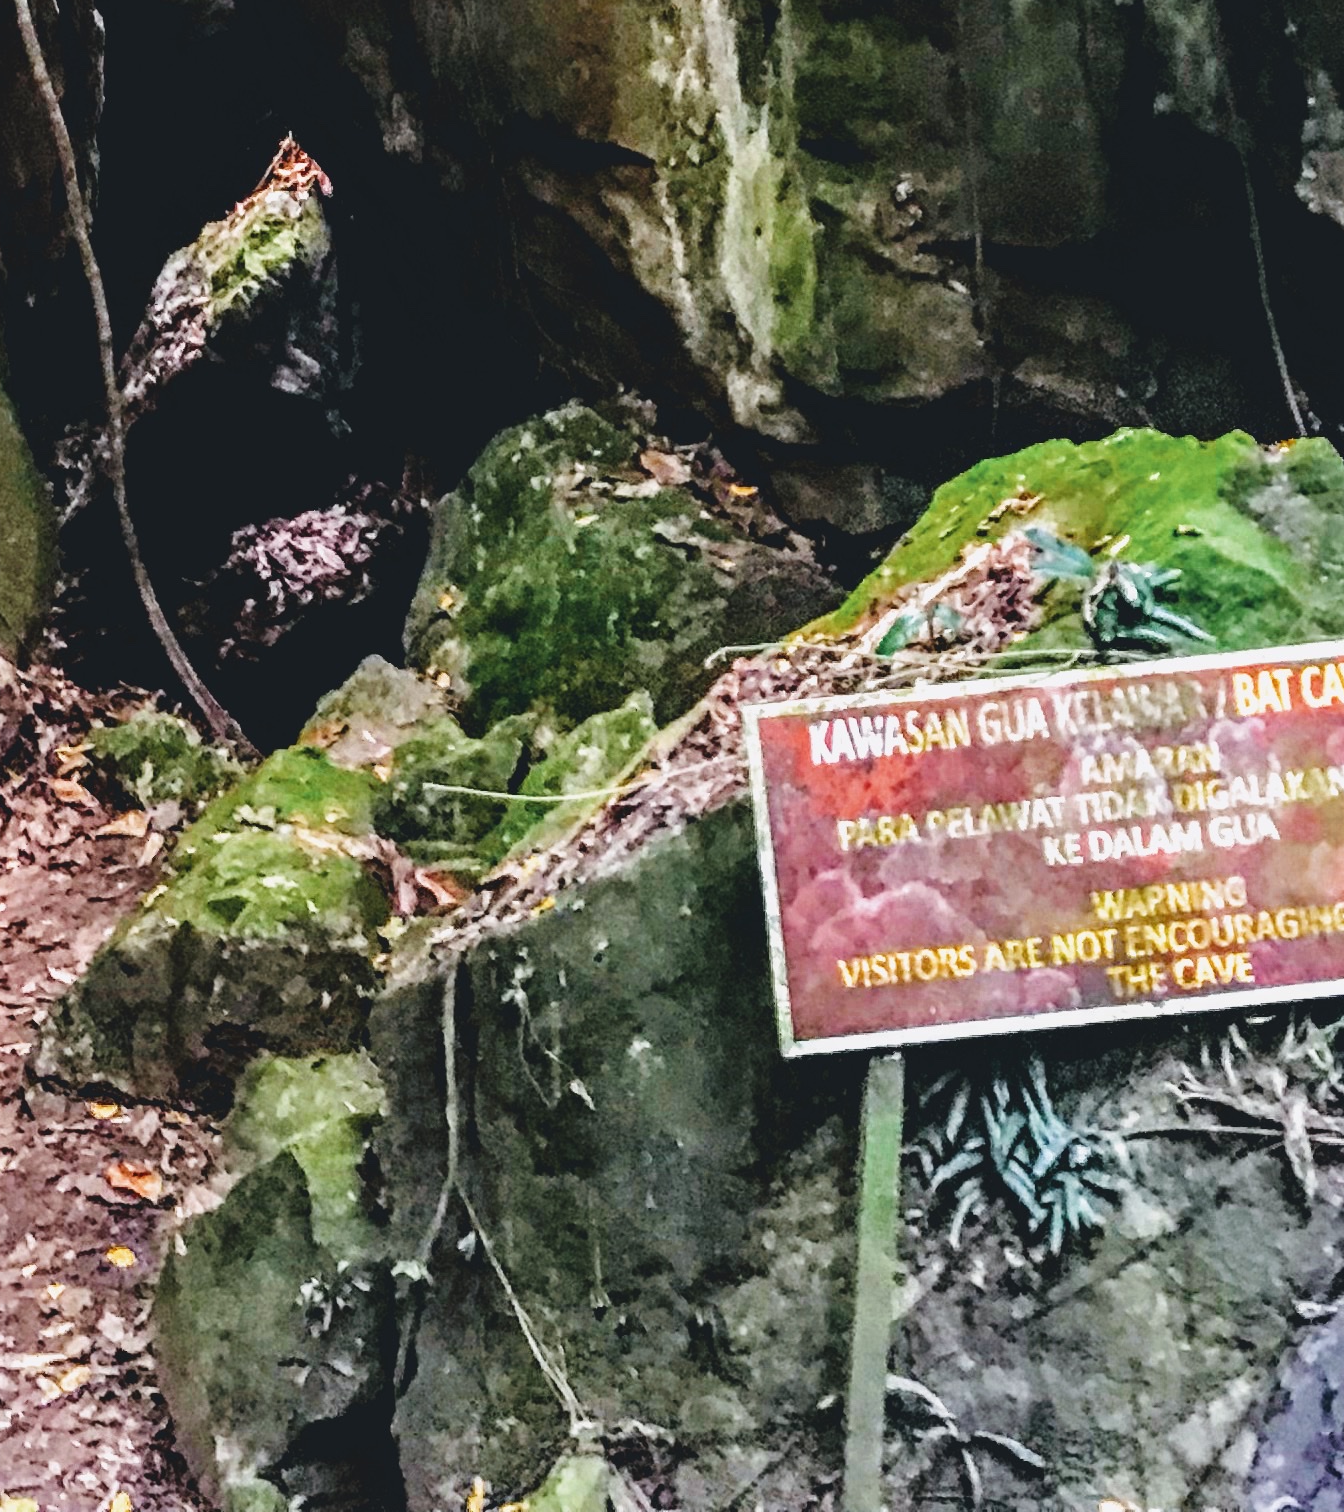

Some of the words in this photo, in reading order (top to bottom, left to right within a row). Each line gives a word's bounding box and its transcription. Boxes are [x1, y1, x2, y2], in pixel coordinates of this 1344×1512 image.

[808, 707, 970, 766] KAWASAN
[977, 696, 1050, 743] GUA
[1232, 667, 1294, 717] BAT
[1081, 741, 1221, 786] AMARAN
[837, 812, 923, 852] PARA
[925, 796, 1066, 840] PELAWAT
[1074, 789, 1158, 825] TIDAK
[1042, 832, 1084, 866] KE
[1088, 819, 1204, 863] DALAM
[1208, 812, 1281, 849] GUA
[1091, 875, 1248, 920] WARNING
[838, 944, 977, 989] VISITORS
[985, 937, 1042, 973] ARE
[1053, 928, 1118, 966] NOT
[1107, 963, 1167, 998] THE
[1172, 952, 1256, 990] CAVE
